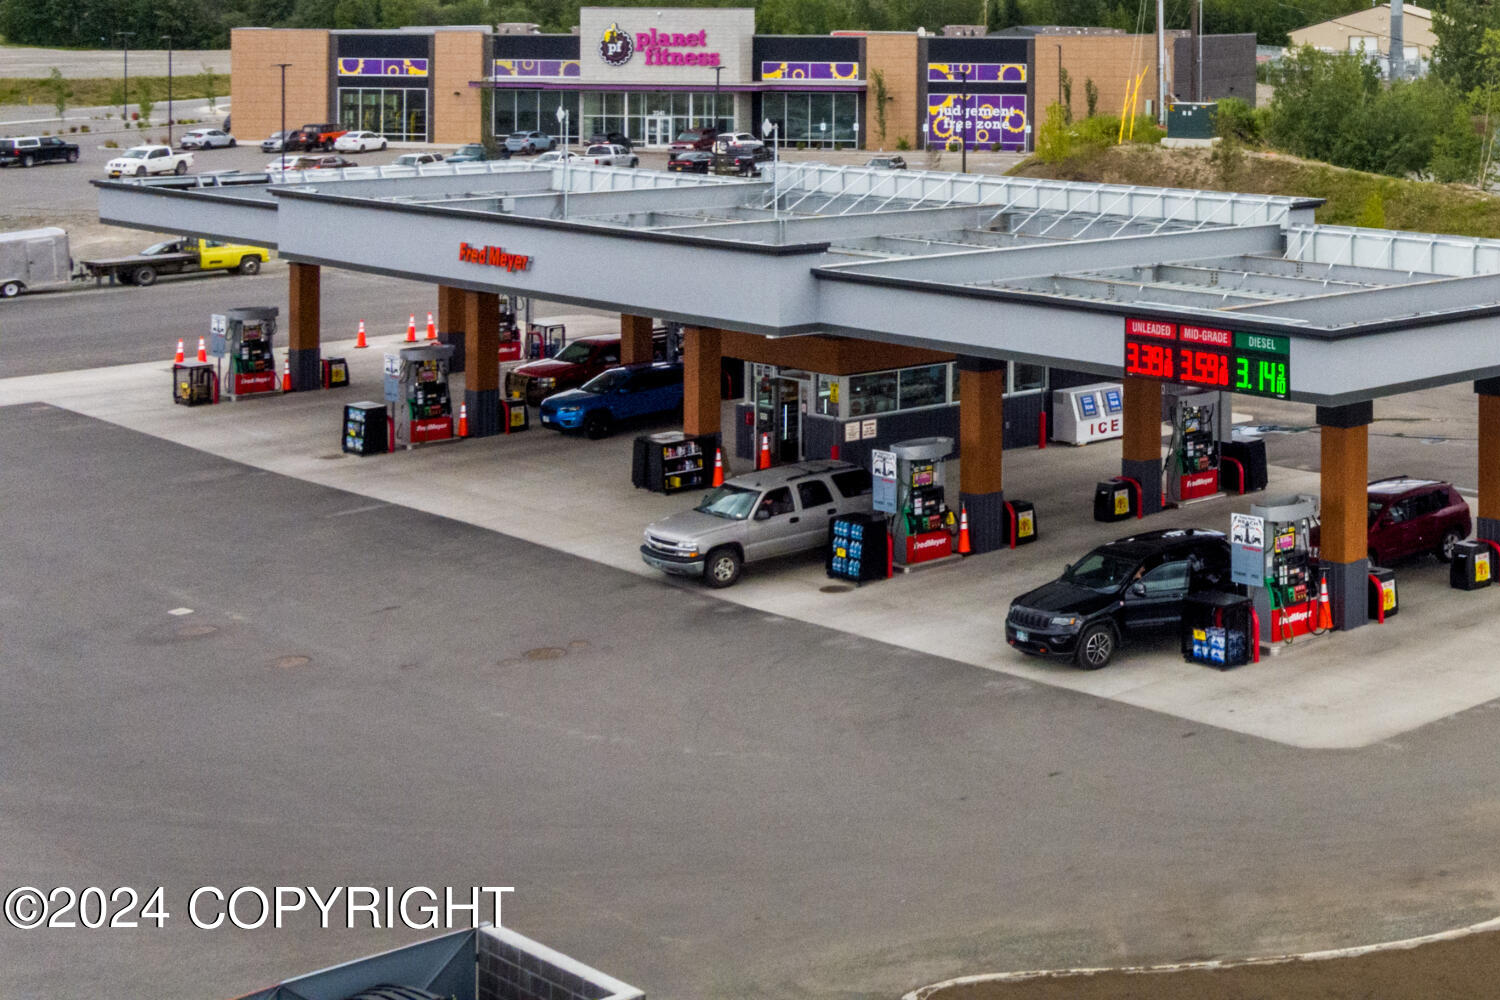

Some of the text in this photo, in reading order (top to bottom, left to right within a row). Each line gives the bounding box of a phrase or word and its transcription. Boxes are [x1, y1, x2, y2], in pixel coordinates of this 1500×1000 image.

[607, 40, 623, 55] pf
[635, 27, 707, 52] planet
[645, 45, 720, 66] fitness
[976, 121, 1010, 130] zone
[458, 242, 529, 273] Fred Meyer
[1132, 322, 1276, 350] UNLEADED MID-GRADE DIESEL
[1090, 419, 1120, 435] ICE
